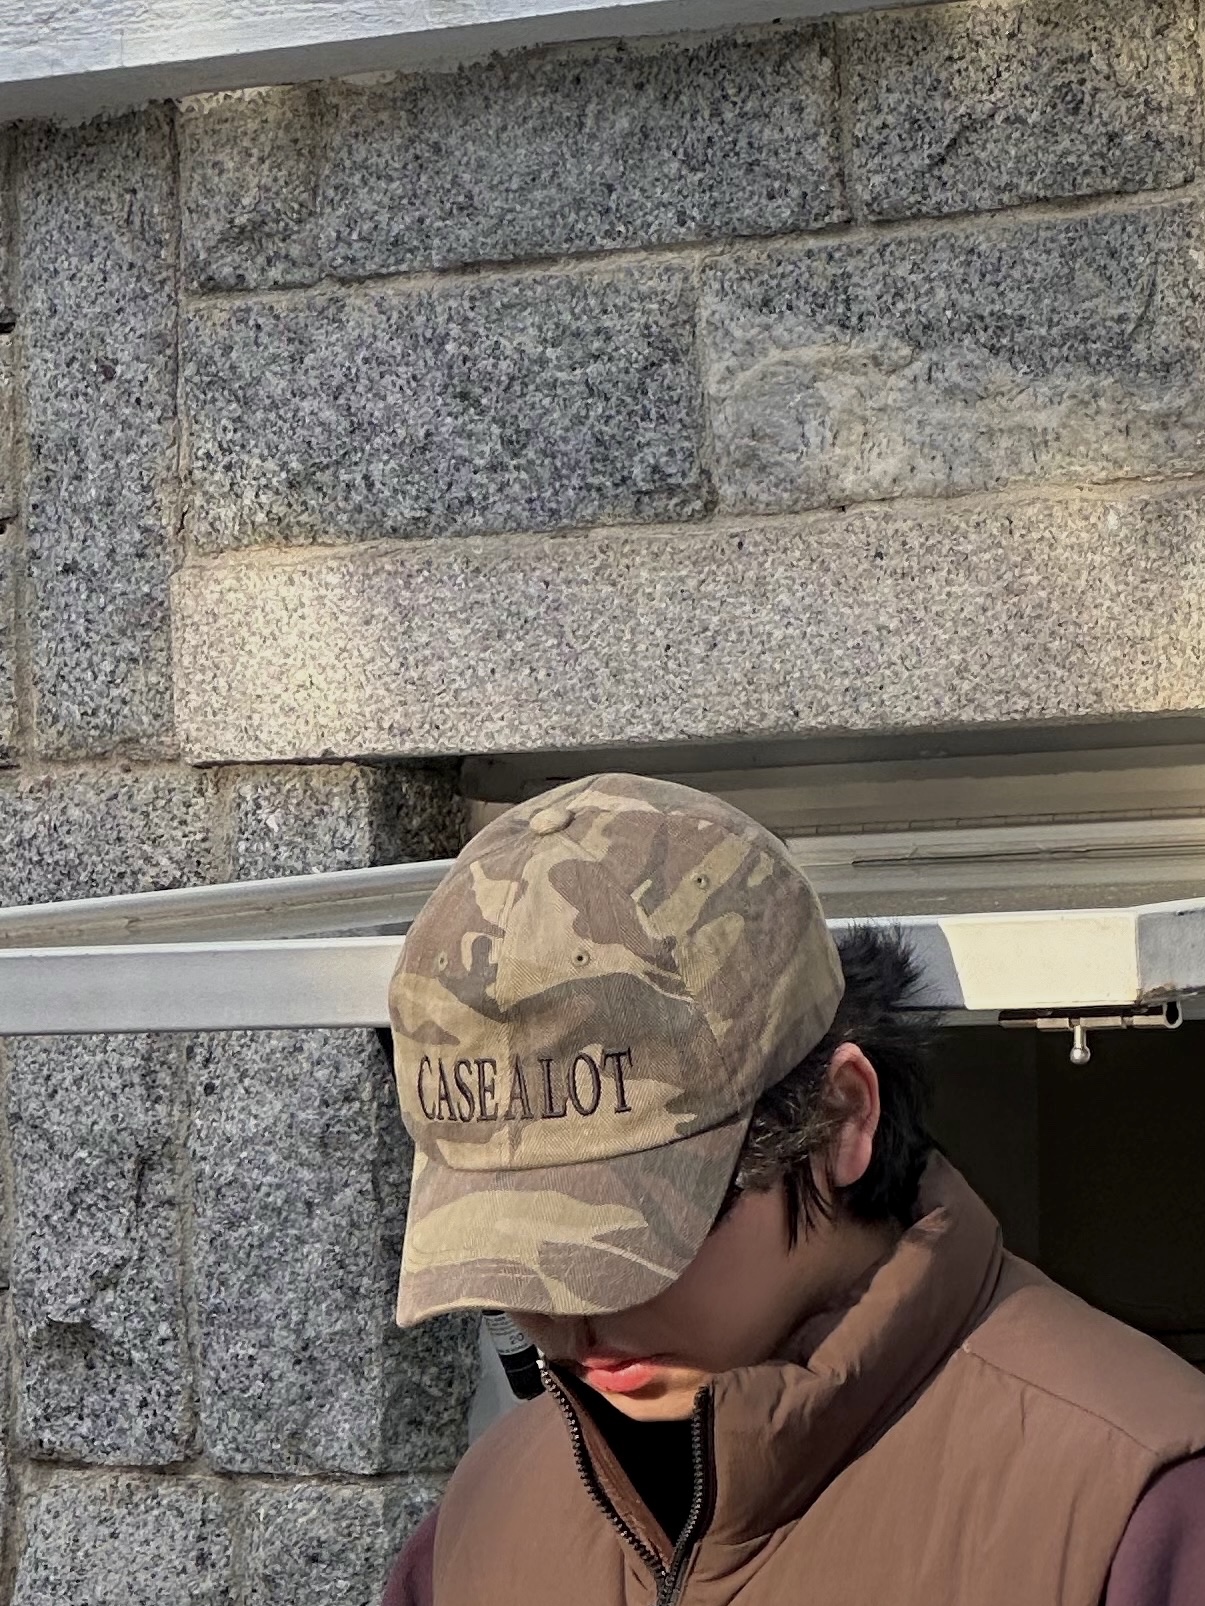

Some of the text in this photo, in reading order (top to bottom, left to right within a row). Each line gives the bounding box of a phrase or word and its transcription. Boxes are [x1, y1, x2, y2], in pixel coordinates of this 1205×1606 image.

[417, 1047, 633, 1122] CASE A LOT
